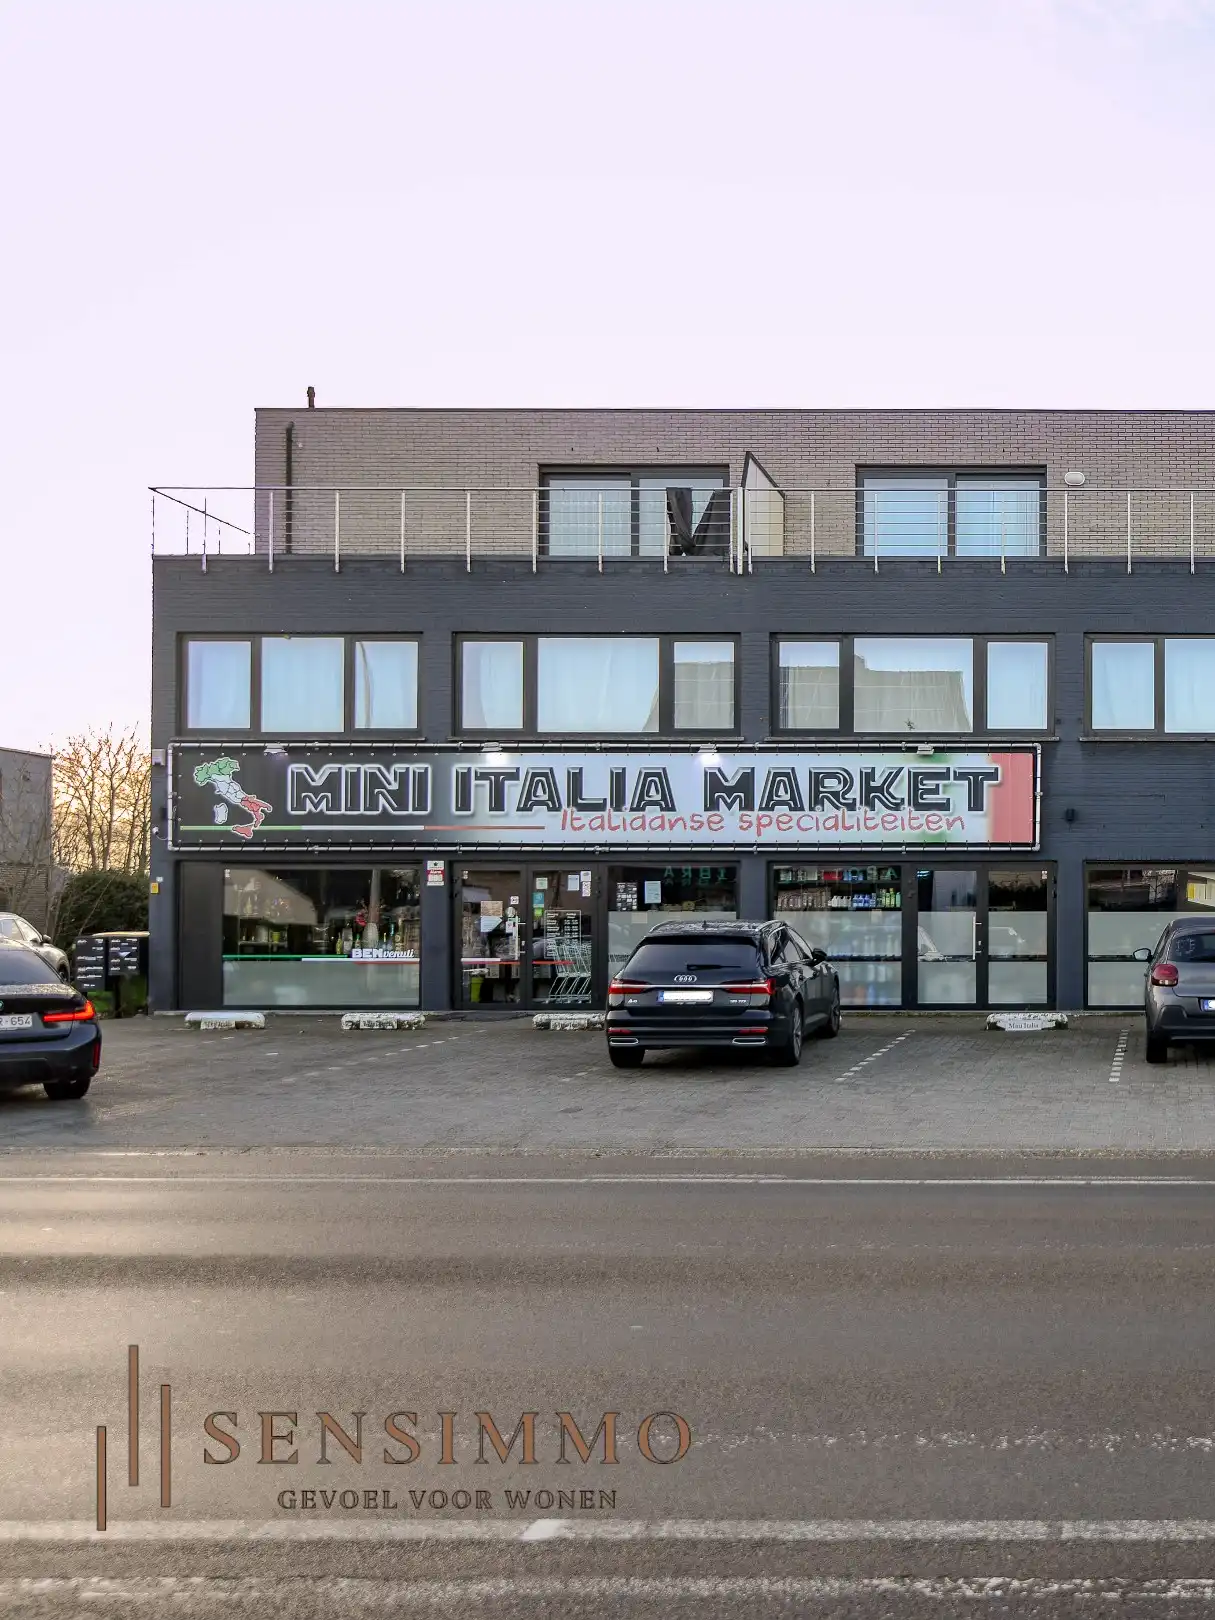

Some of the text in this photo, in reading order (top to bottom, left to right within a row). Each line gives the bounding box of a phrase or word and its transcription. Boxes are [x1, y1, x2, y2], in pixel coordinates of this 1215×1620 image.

[287, 763, 1000, 815] MINI ITALIA MARKET
[560, 808, 967, 838] Italiaanse specialiteiten
